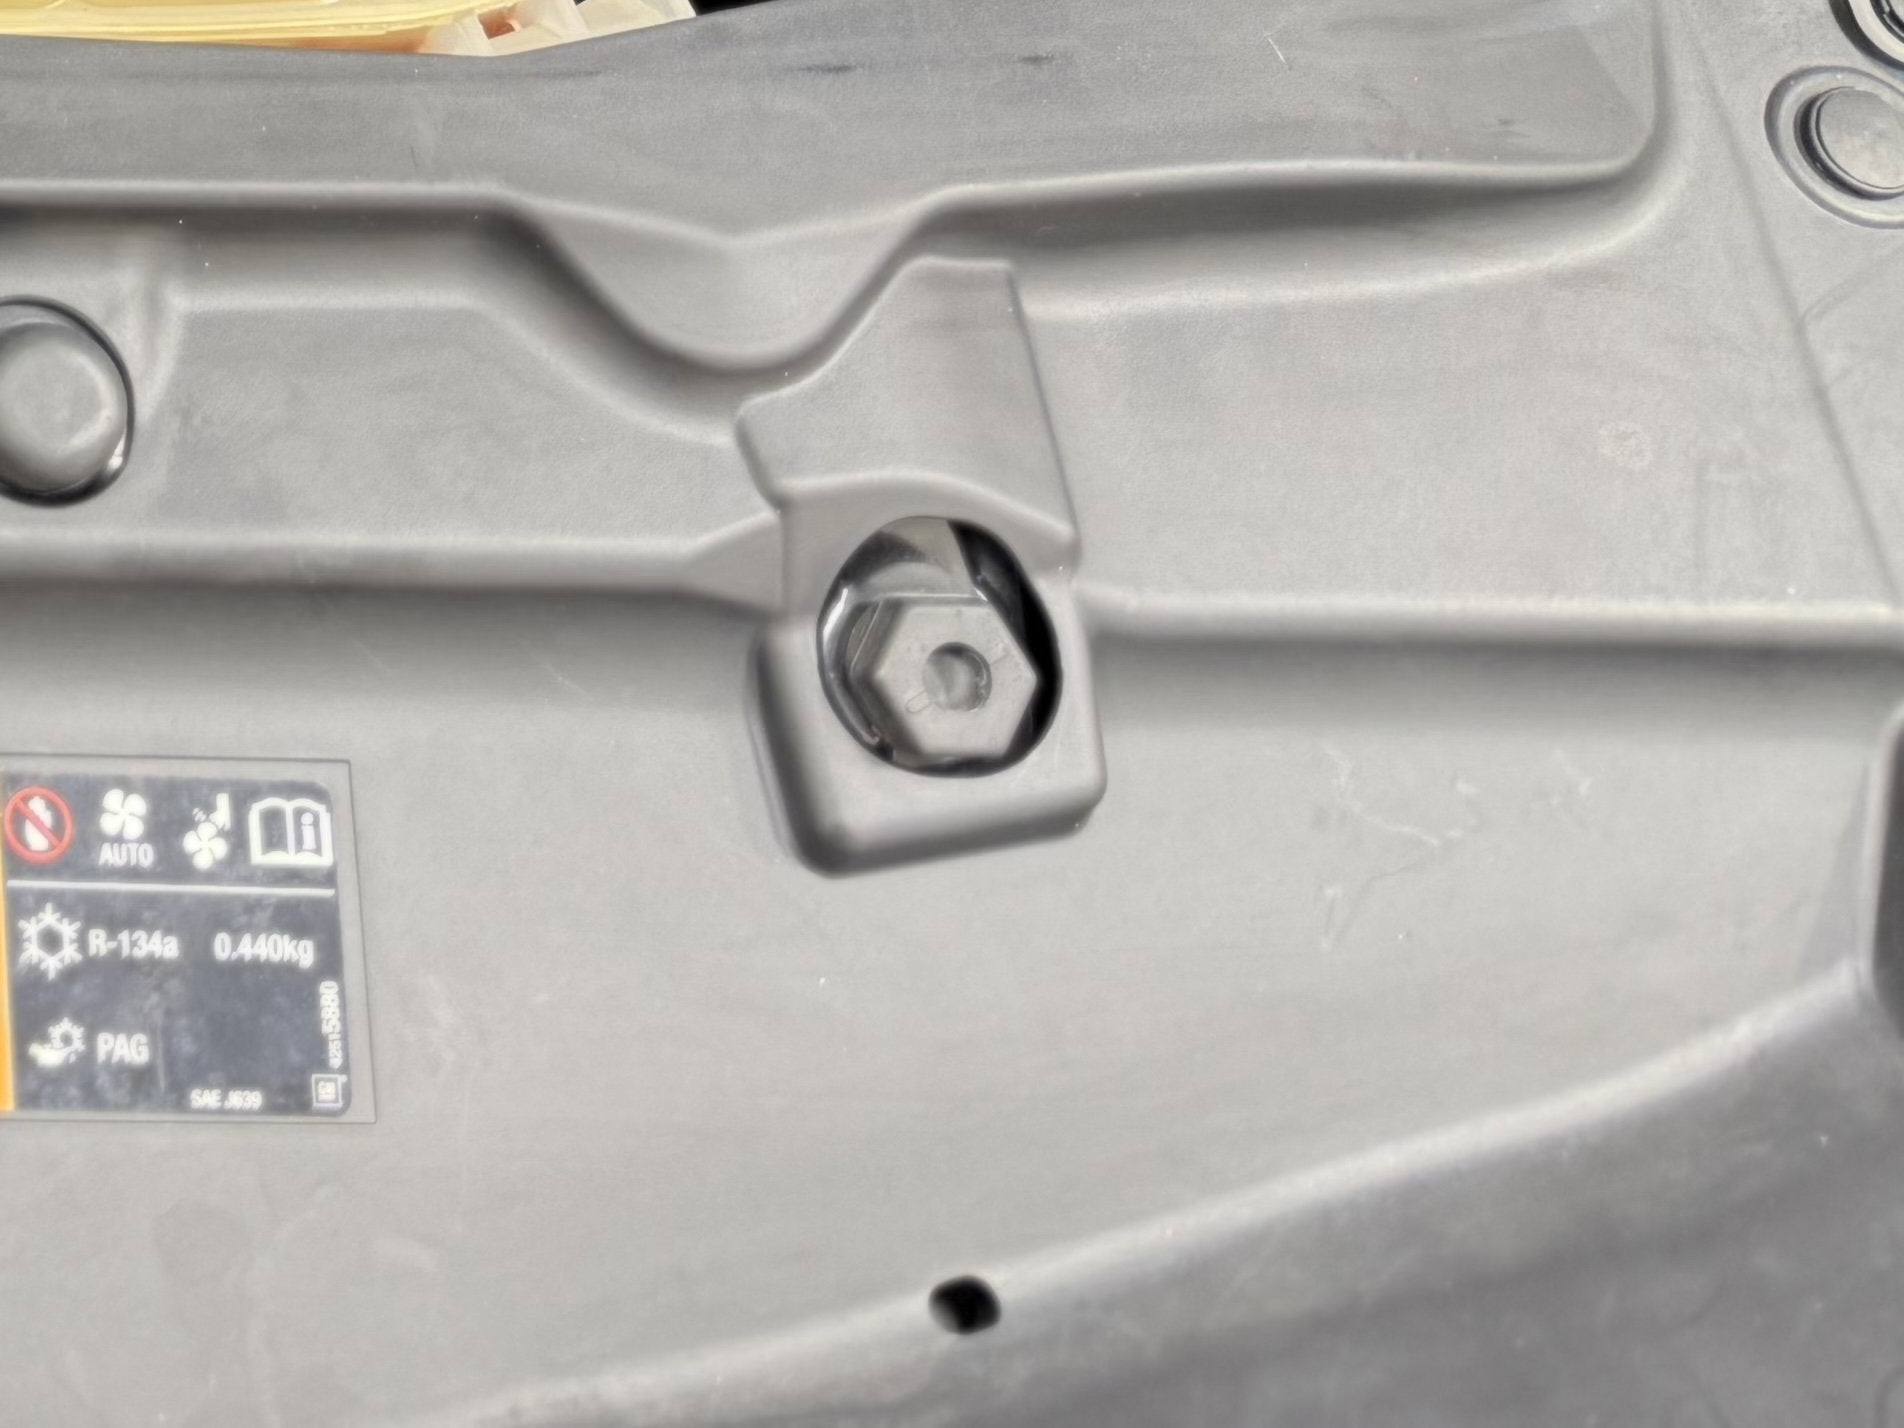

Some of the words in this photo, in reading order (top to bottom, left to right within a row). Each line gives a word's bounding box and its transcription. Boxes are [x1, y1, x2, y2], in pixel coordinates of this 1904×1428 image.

[99, 842, 153, 867] AUTO
[89, 929, 180, 959] R-134a
[214, 933, 315, 967] 0.440kg
[97, 1032, 149, 1063] PAG
[190, 1089, 221, 1110] SAE
[223, 1089, 262, 1110] J639
